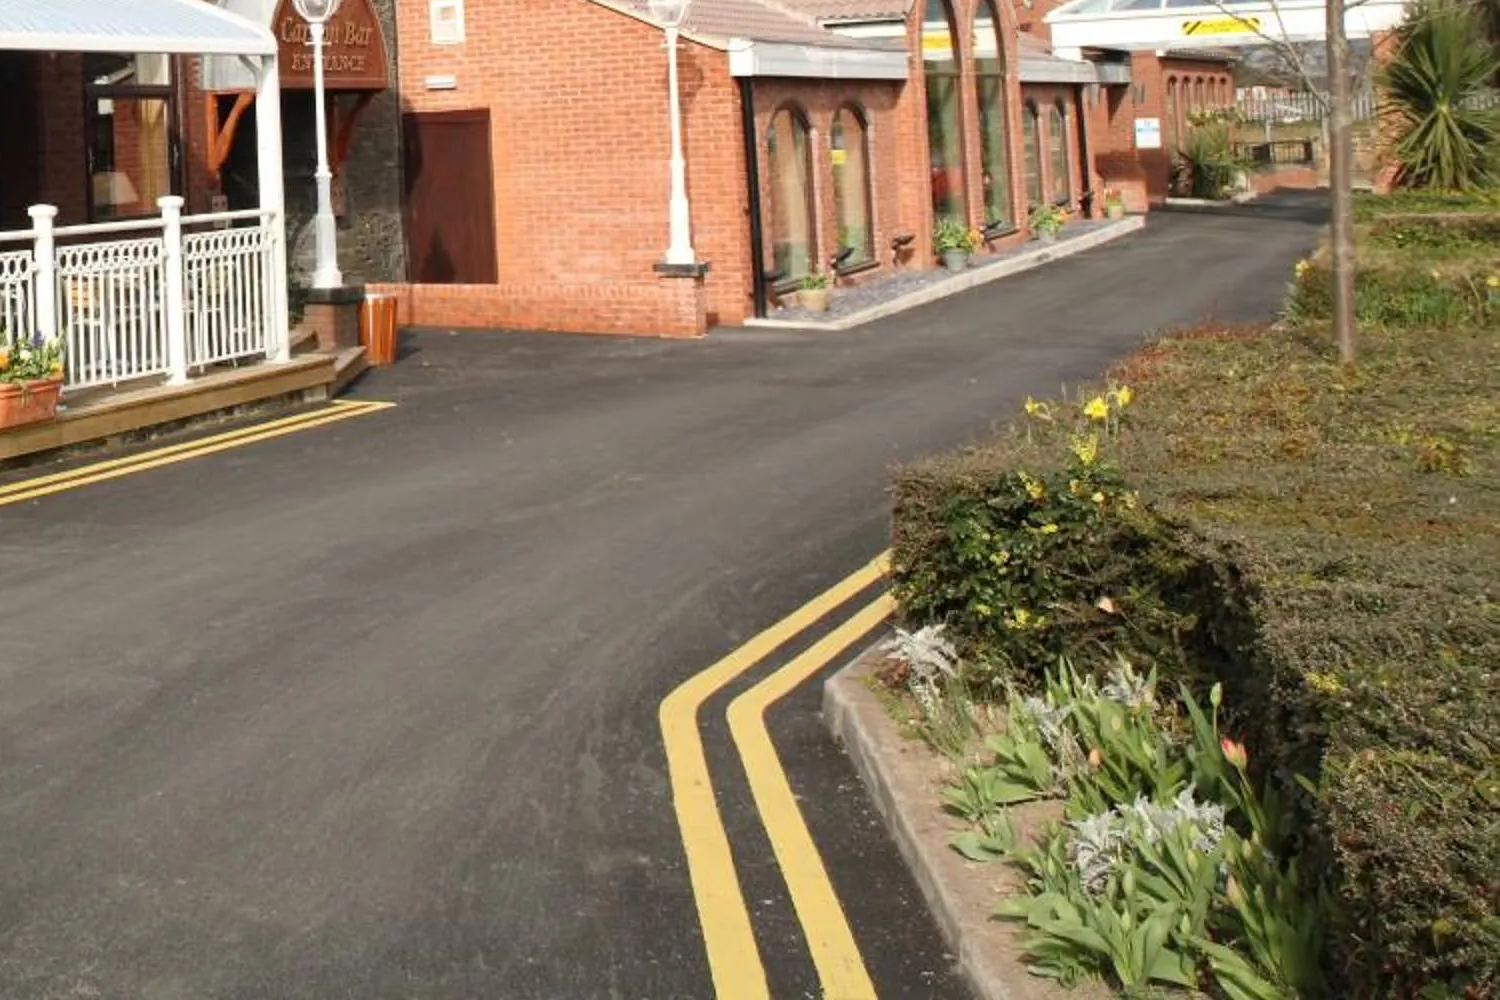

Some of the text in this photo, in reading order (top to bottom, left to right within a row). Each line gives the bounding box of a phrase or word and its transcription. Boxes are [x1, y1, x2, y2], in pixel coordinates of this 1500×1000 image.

[280, 16, 374, 46] Carn Bar
[291, 53, 365, 71] ENRANCE
